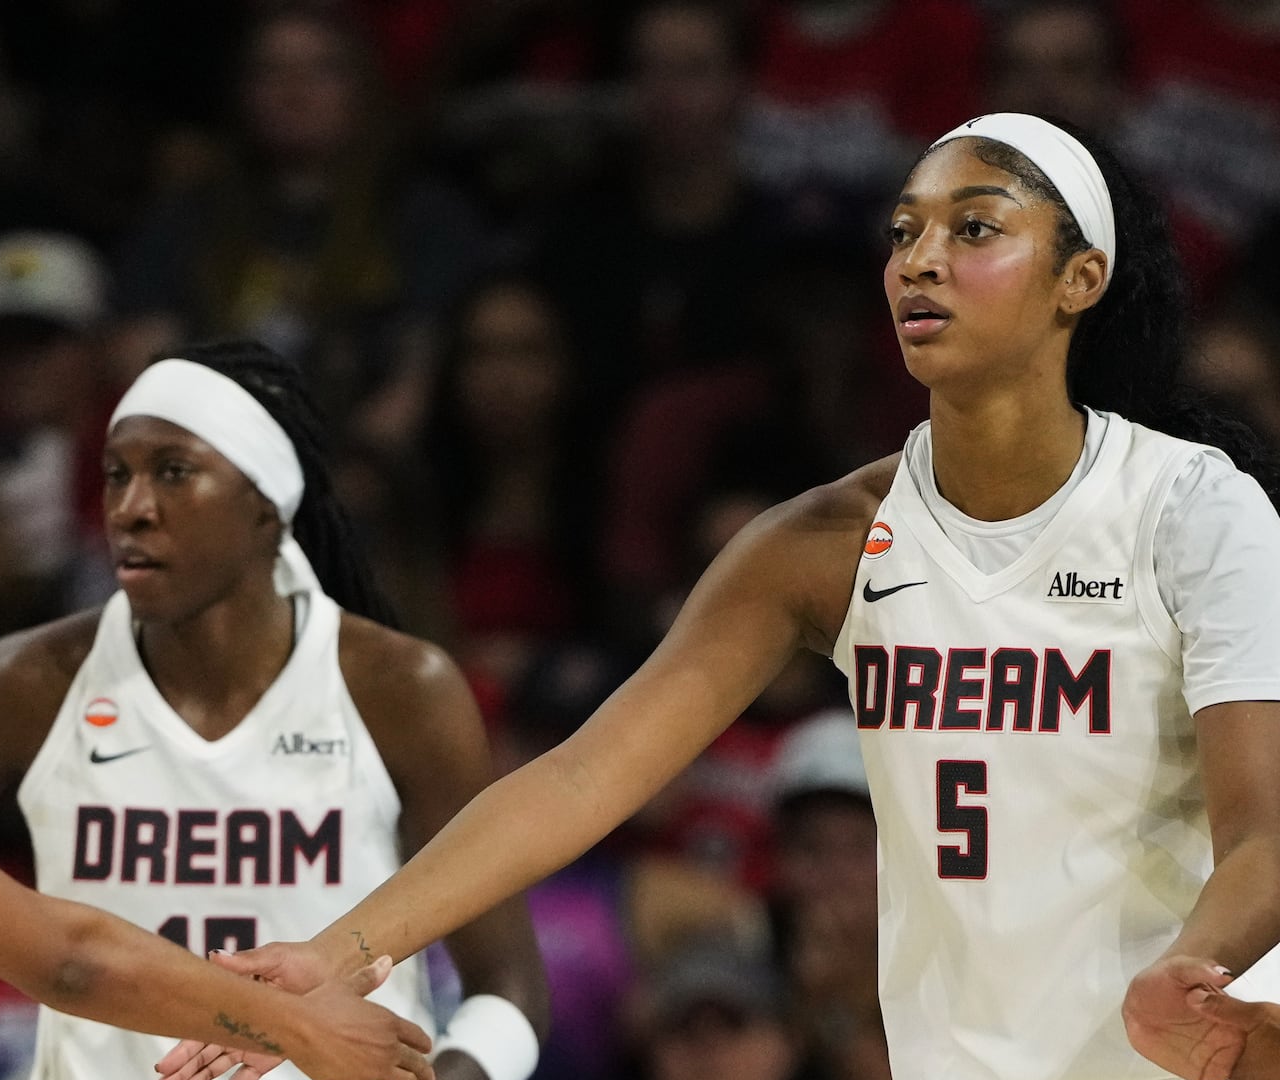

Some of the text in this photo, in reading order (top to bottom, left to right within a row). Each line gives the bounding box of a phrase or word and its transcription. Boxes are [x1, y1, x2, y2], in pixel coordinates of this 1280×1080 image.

[1047, 571, 1124, 600] Albert
[854, 644, 1112, 734] DREAM
[73, 805, 342, 886] DREAM
[936, 759, 988, 879] 5
